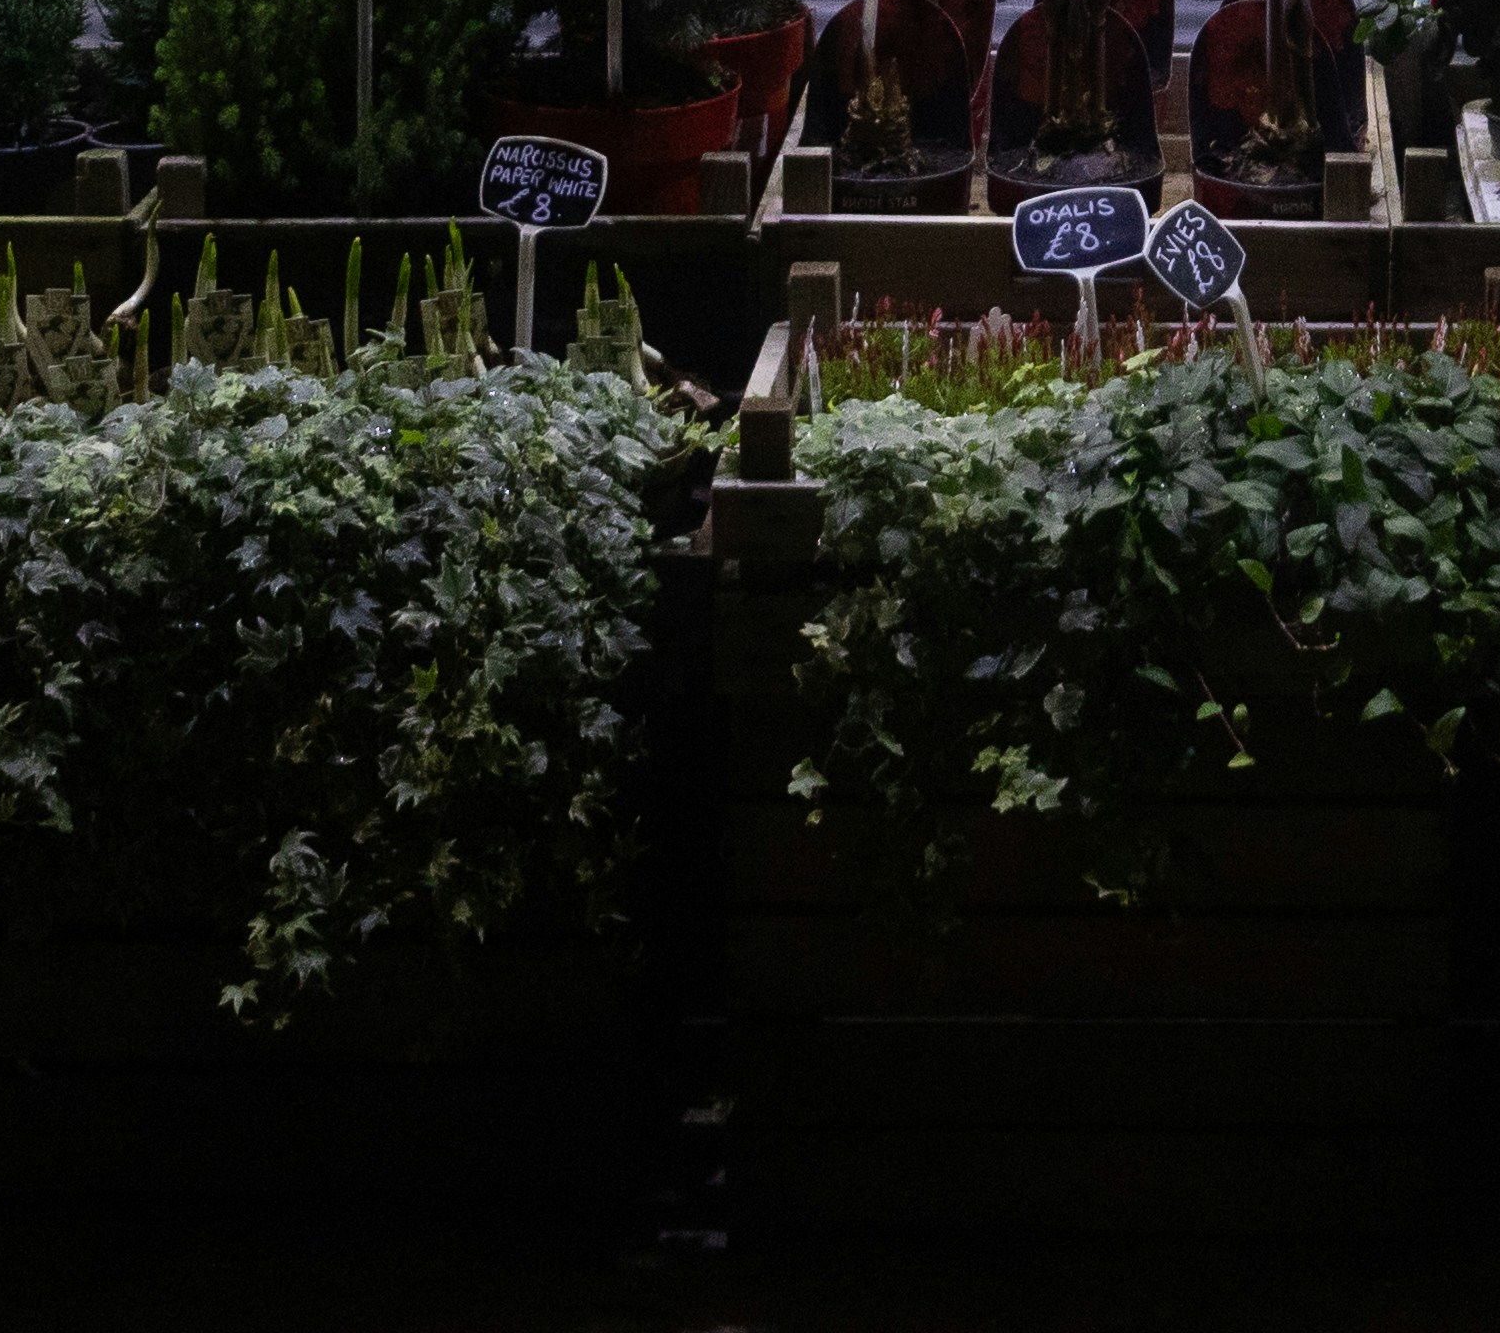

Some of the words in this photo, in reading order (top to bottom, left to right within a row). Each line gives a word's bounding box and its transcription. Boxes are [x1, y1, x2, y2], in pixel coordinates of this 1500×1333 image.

[496, 144, 592, 179] NARCISSUS
[490, 164, 545, 187] PAPER
[548, 176, 598, 198] WHITE
[1029, 198, 1115, 224] OXALIS
[1156, 209, 1206, 272] IVIES
